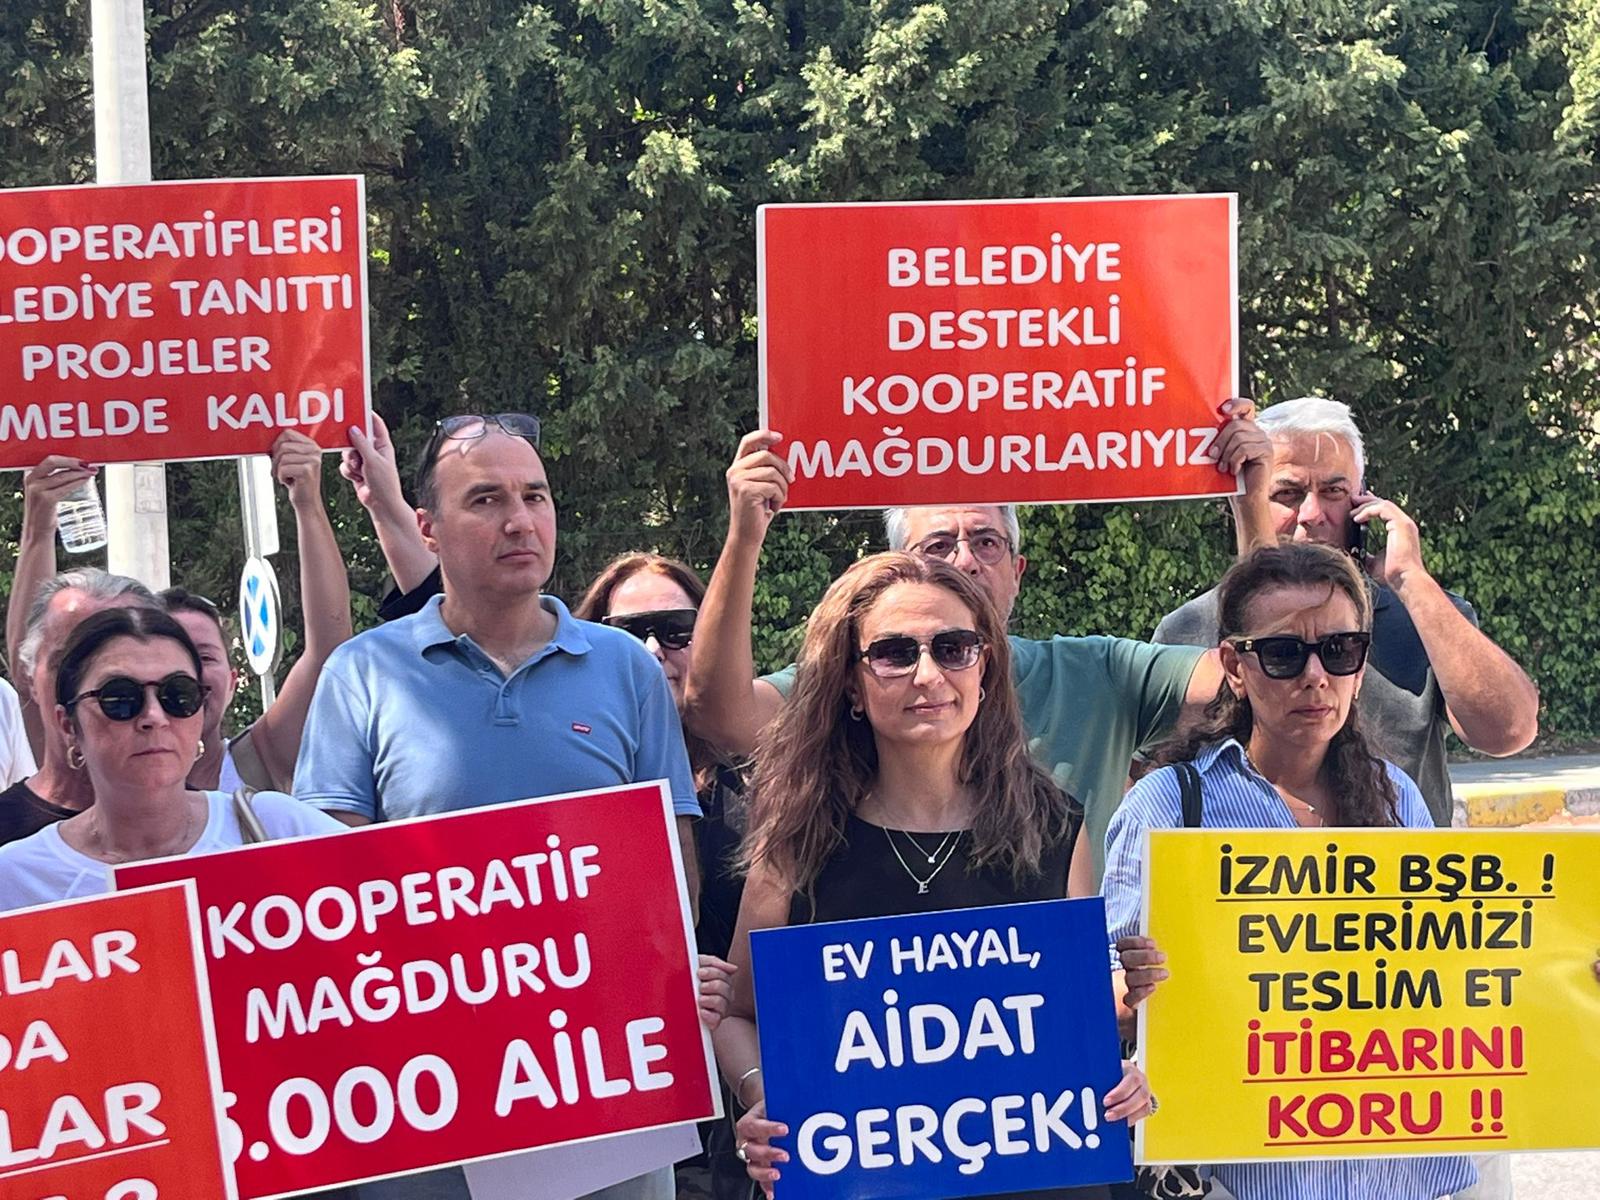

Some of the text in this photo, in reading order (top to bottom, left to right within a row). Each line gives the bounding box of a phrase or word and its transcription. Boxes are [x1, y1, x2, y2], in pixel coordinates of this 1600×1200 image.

[0, 205, 342, 266] OPERATİFLERİ
[887, 232, 1121, 287] BELEDİYE
[169, 273, 353, 318] TANITTI
[887, 294, 1121, 351] DESTEKLİ
[22, 336, 271, 381] PROJELER
[843, 356, 1166, 416] KOOPERATİF
[0, 388, 344, 441] MELDE KALDI
[787, 426, 1219, 480] MAĞDURLARIYIZ
[206, 834, 602, 960] KOOPERATİF
[1220, 843, 1555, 902] İZMİR BŞB. !
[822, 926, 1042, 982] EV HAYAL,
[1237, 899, 1533, 954] EVLERİMİZİ
[0, 929, 141, 995] LAR
[245, 932, 592, 1044] MAĞDURU
[1248, 958, 1522, 1013] TESLİM ET
[0, 1019, 69, 1071] A
[834, 988, 1045, 1073] AİDAT
[1246, 1017, 1523, 1076] İTİBARINI
[495, 1009, 675, 1118] AİLE
[797, 1086, 1101, 1175] GERÇEK!
[1268, 1088, 1504, 1139] KORU !!
